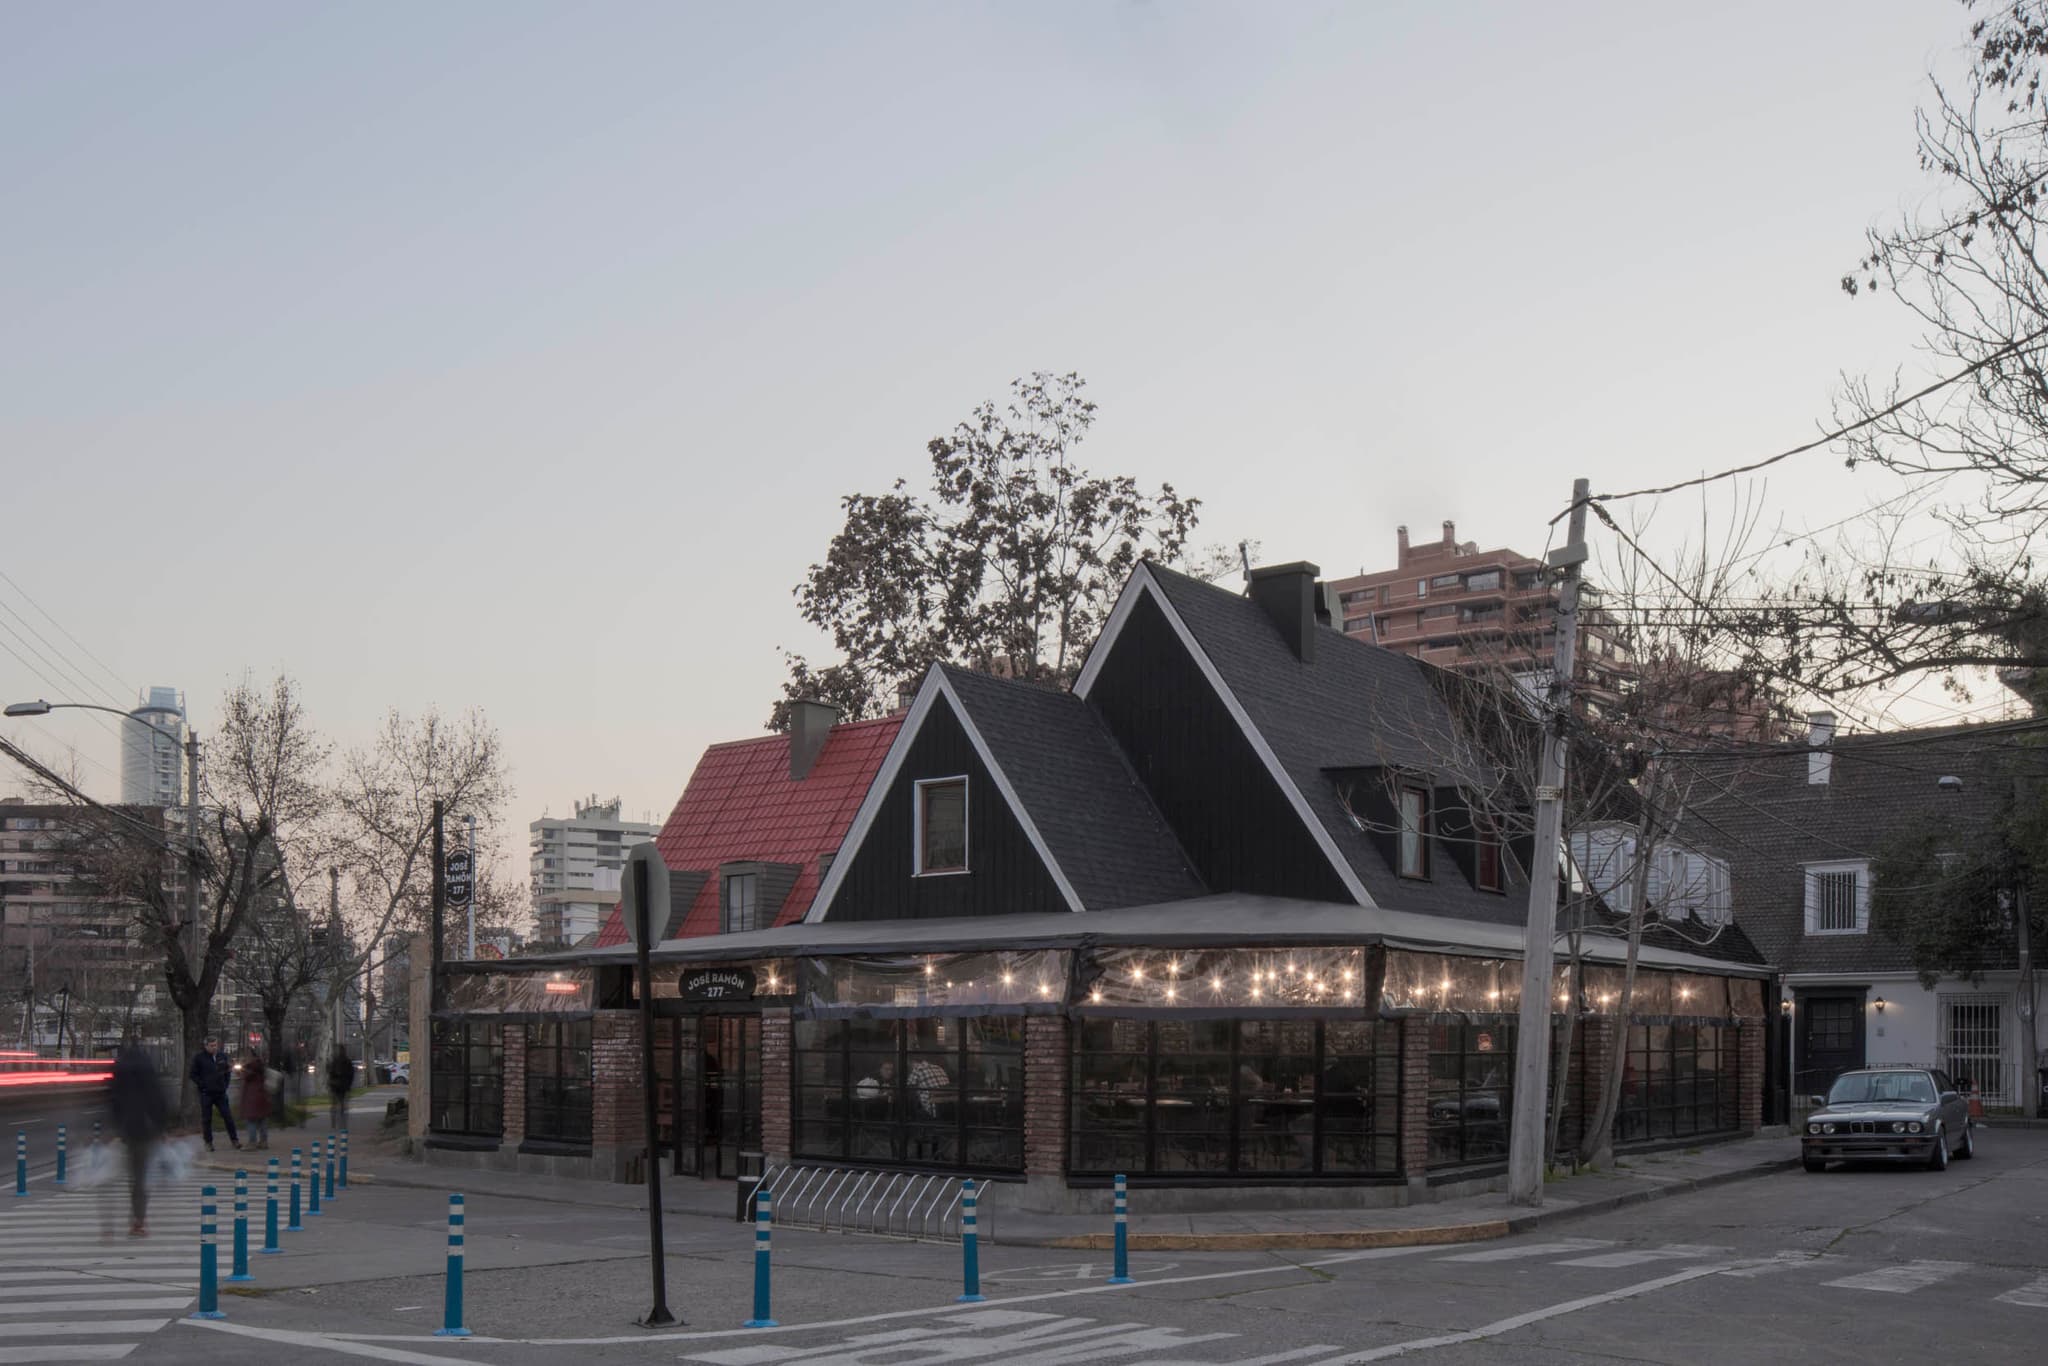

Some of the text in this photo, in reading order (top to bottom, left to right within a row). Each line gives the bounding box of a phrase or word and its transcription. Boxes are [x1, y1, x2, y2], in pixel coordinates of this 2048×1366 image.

[450, 860, 468, 871] JOSÉ
[447, 872, 472, 882] RAMÓN
[453, 885, 464, 894] 277
[688, 971, 745, 991] JOSÉ RAMÓN
[707, 986, 724, 998] 277
